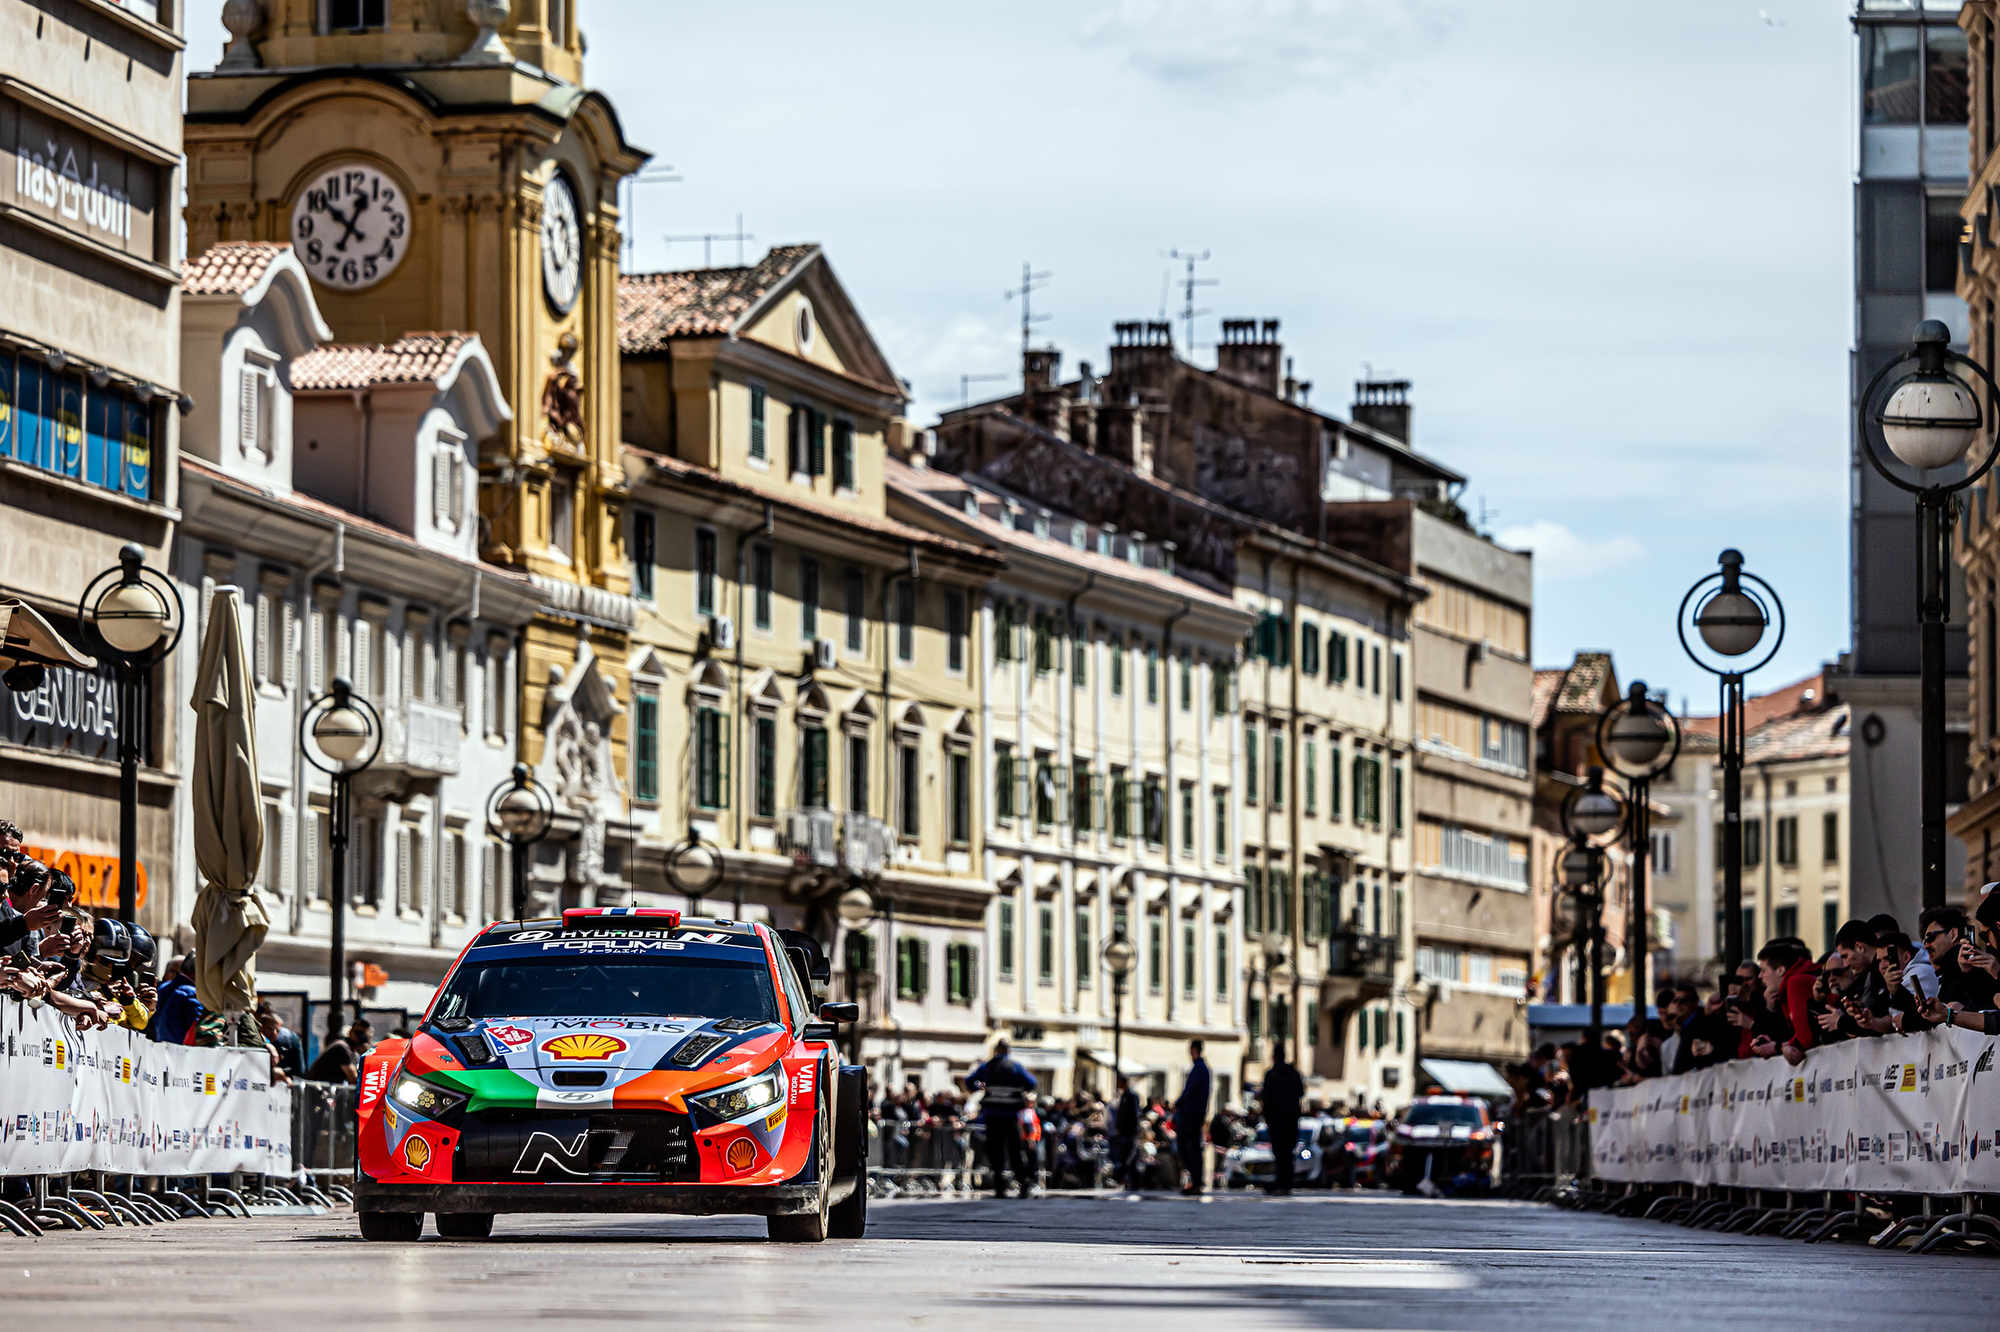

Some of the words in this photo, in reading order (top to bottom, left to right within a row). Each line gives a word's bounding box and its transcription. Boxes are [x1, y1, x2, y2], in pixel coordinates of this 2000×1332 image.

[328, 176, 339, 201] 11
[344, 171, 365, 196] 12
[372, 177, 379, 201] 1
[307, 189, 327, 213] 10
[382, 187, 395, 213] 2
[298, 214, 314, 239] 9
[389, 212, 405, 239] 3
[307, 239, 322, 265] 8
[381, 237, 394, 261] 4
[326, 255, 339, 279] 7
[342, 258, 358, 284] 6
[363, 253, 379, 279] 5
[542, 940, 686, 951] FORUM8
[561, 930, 669, 938] HYUNDAI
[552, 1020, 685, 1034] MOBIS
